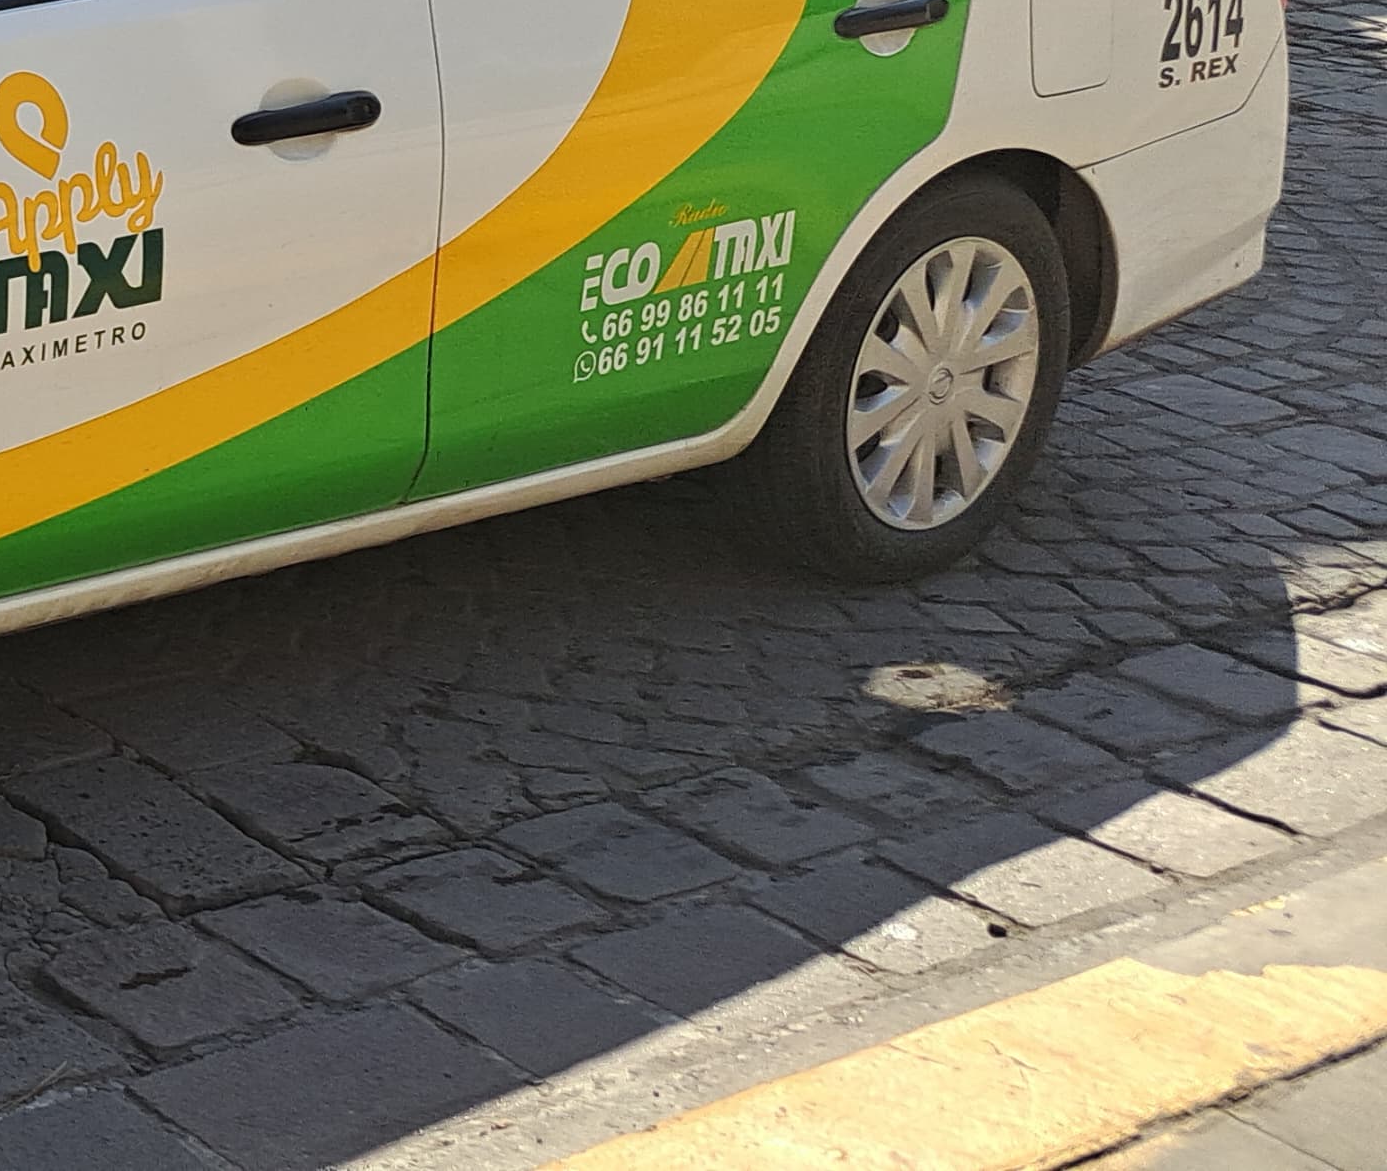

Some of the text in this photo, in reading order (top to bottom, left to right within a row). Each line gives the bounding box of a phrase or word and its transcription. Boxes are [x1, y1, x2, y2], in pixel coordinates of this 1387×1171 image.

[1158, 53, 1239, 89] S. REX
[580, 209, 796, 312] ECO TAXI
[597, 305, 782, 376] 66 91 11 52 05
[601, 272, 784, 342] 66 99 86 11 11
